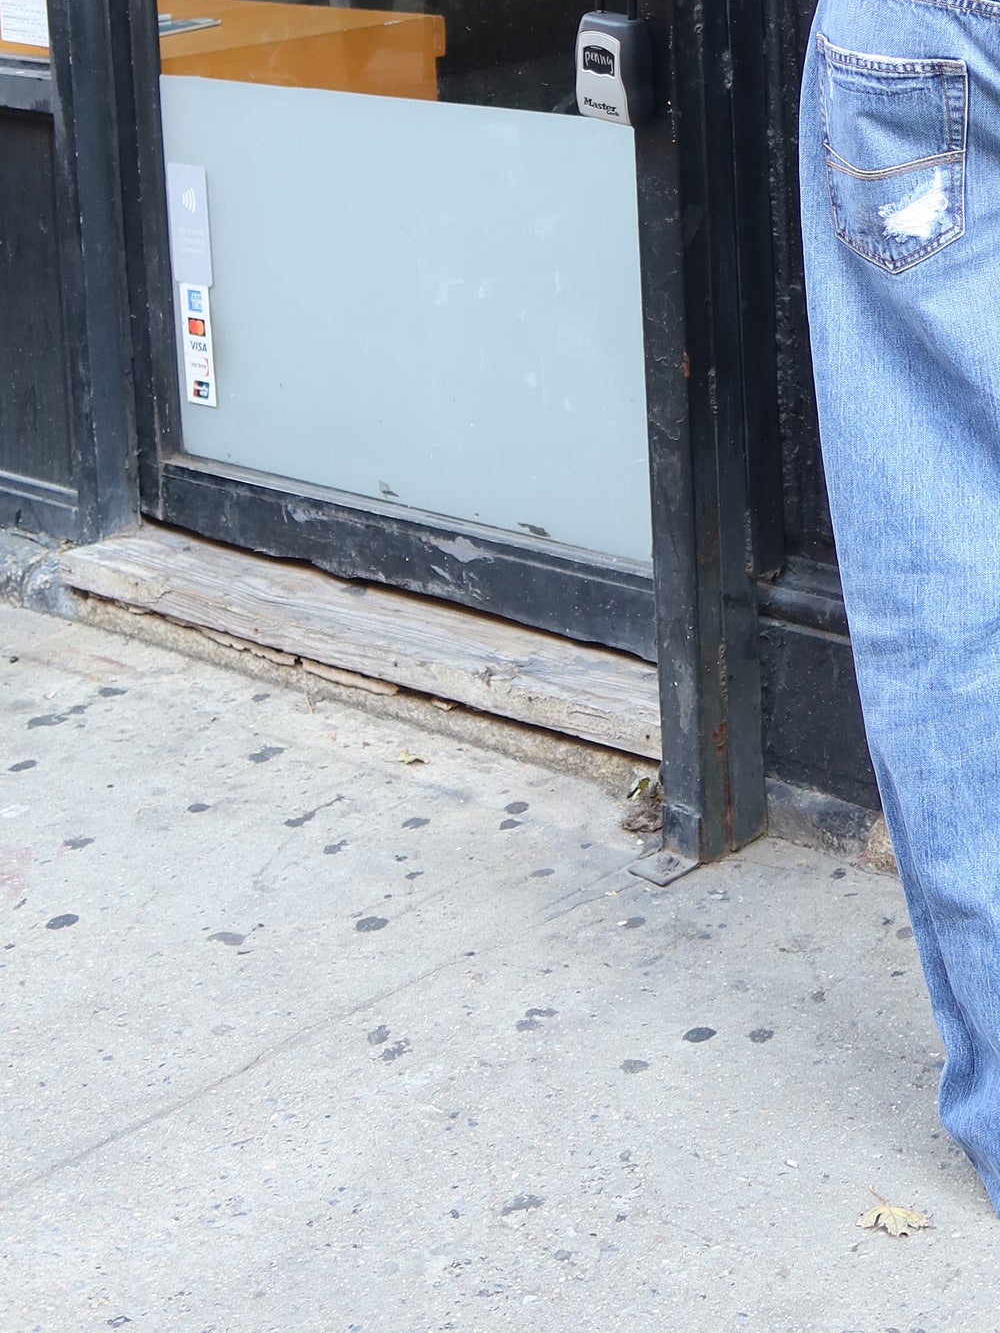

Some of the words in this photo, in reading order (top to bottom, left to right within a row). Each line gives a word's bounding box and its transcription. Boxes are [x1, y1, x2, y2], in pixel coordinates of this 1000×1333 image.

[584, 51, 613, 74] penny
[583, 97, 617, 112] Master
[189, 341, 207, 353] VISA
